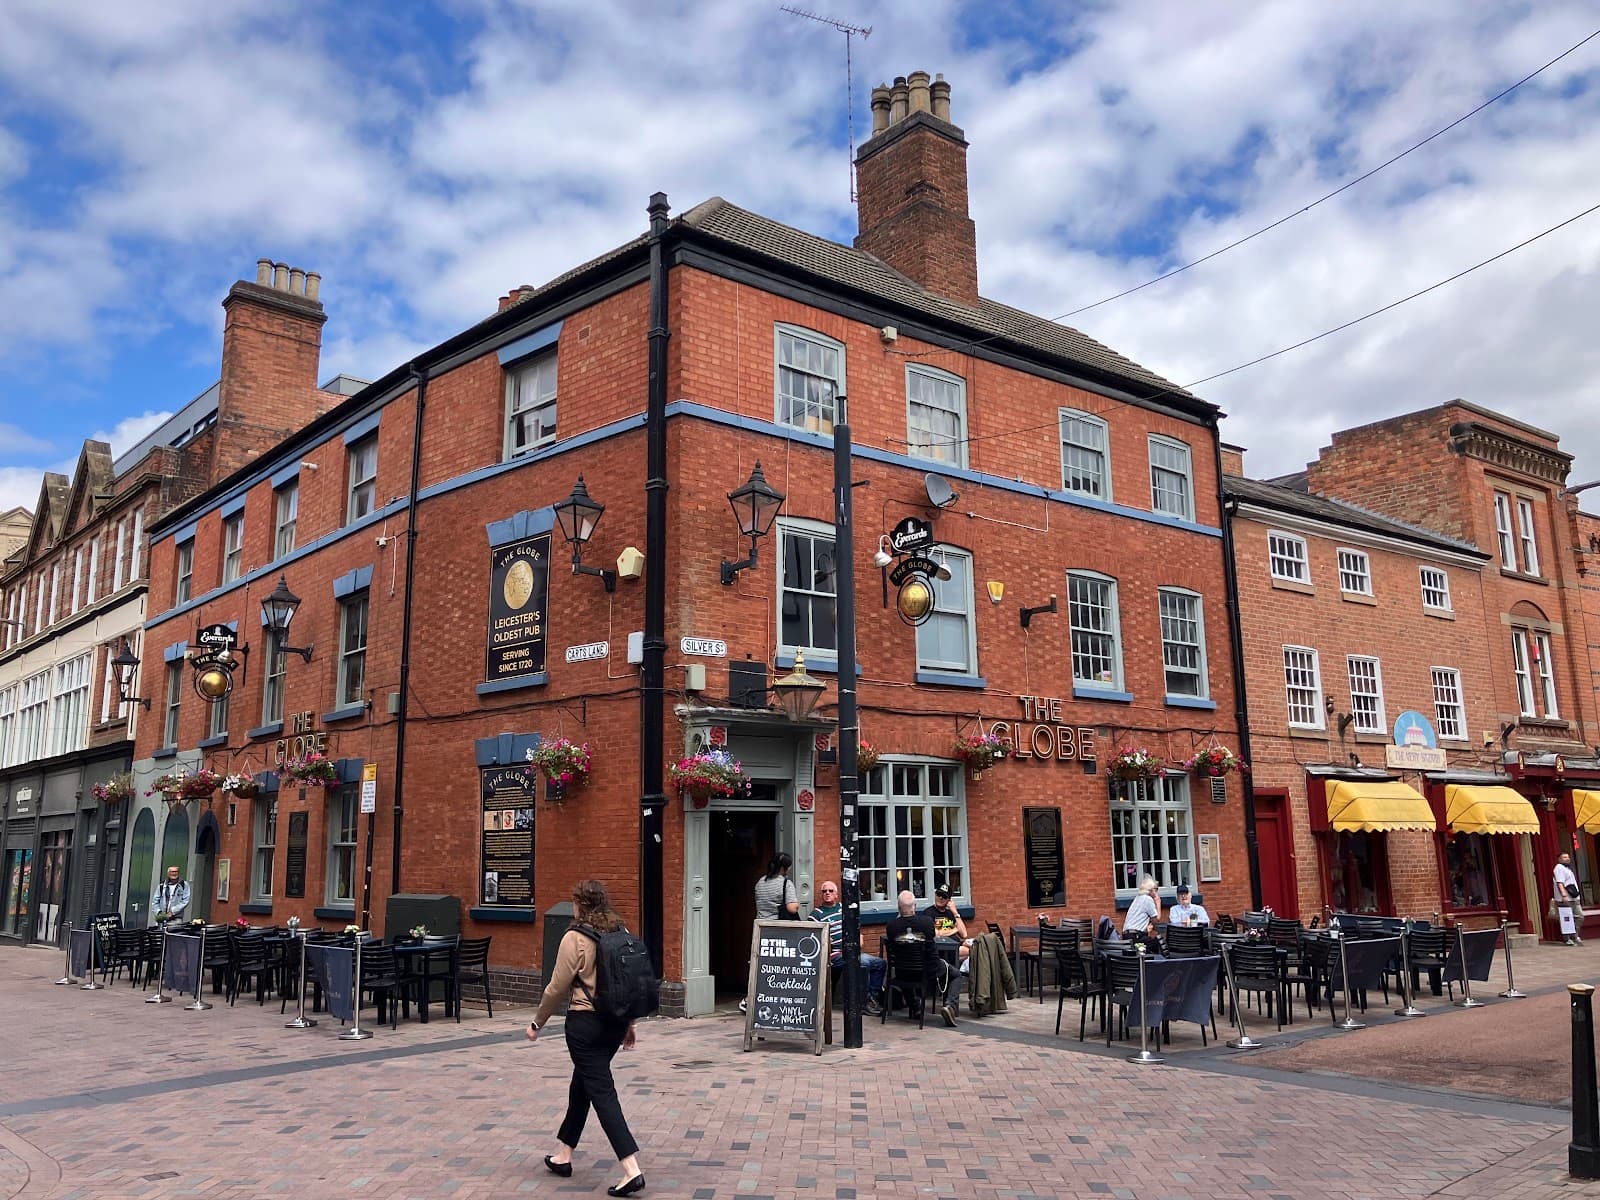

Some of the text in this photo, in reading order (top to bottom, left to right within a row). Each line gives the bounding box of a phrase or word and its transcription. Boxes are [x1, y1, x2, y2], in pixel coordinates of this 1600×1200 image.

[895, 528, 928, 548] Everards
[500, 546, 541, 567] THE GLOBE
[893, 561, 932, 580] THE GLOBE
[494, 611, 541, 630] LEICESTER'S
[200, 632, 235, 643] Everards
[493, 625, 540, 643] OLDEST PUB
[502, 648, 530, 661] SERVING
[567, 644, 605, 660] CARTS LANE
[685, 640, 713, 654] SILVER
[498, 660, 533, 673] SINCE 1720
[1020, 695, 1064, 722] THE
[291, 711, 312, 734] THE
[990, 721, 1097, 761] GLOBE
[489, 770, 530, 790] THE GLOBE
[761, 947, 797, 958] GLOBE
[761, 964, 817, 976] SUNDAY ROASTS
[767, 975, 812, 991] Cocktails
[779, 1005, 803, 1016] VINYL
